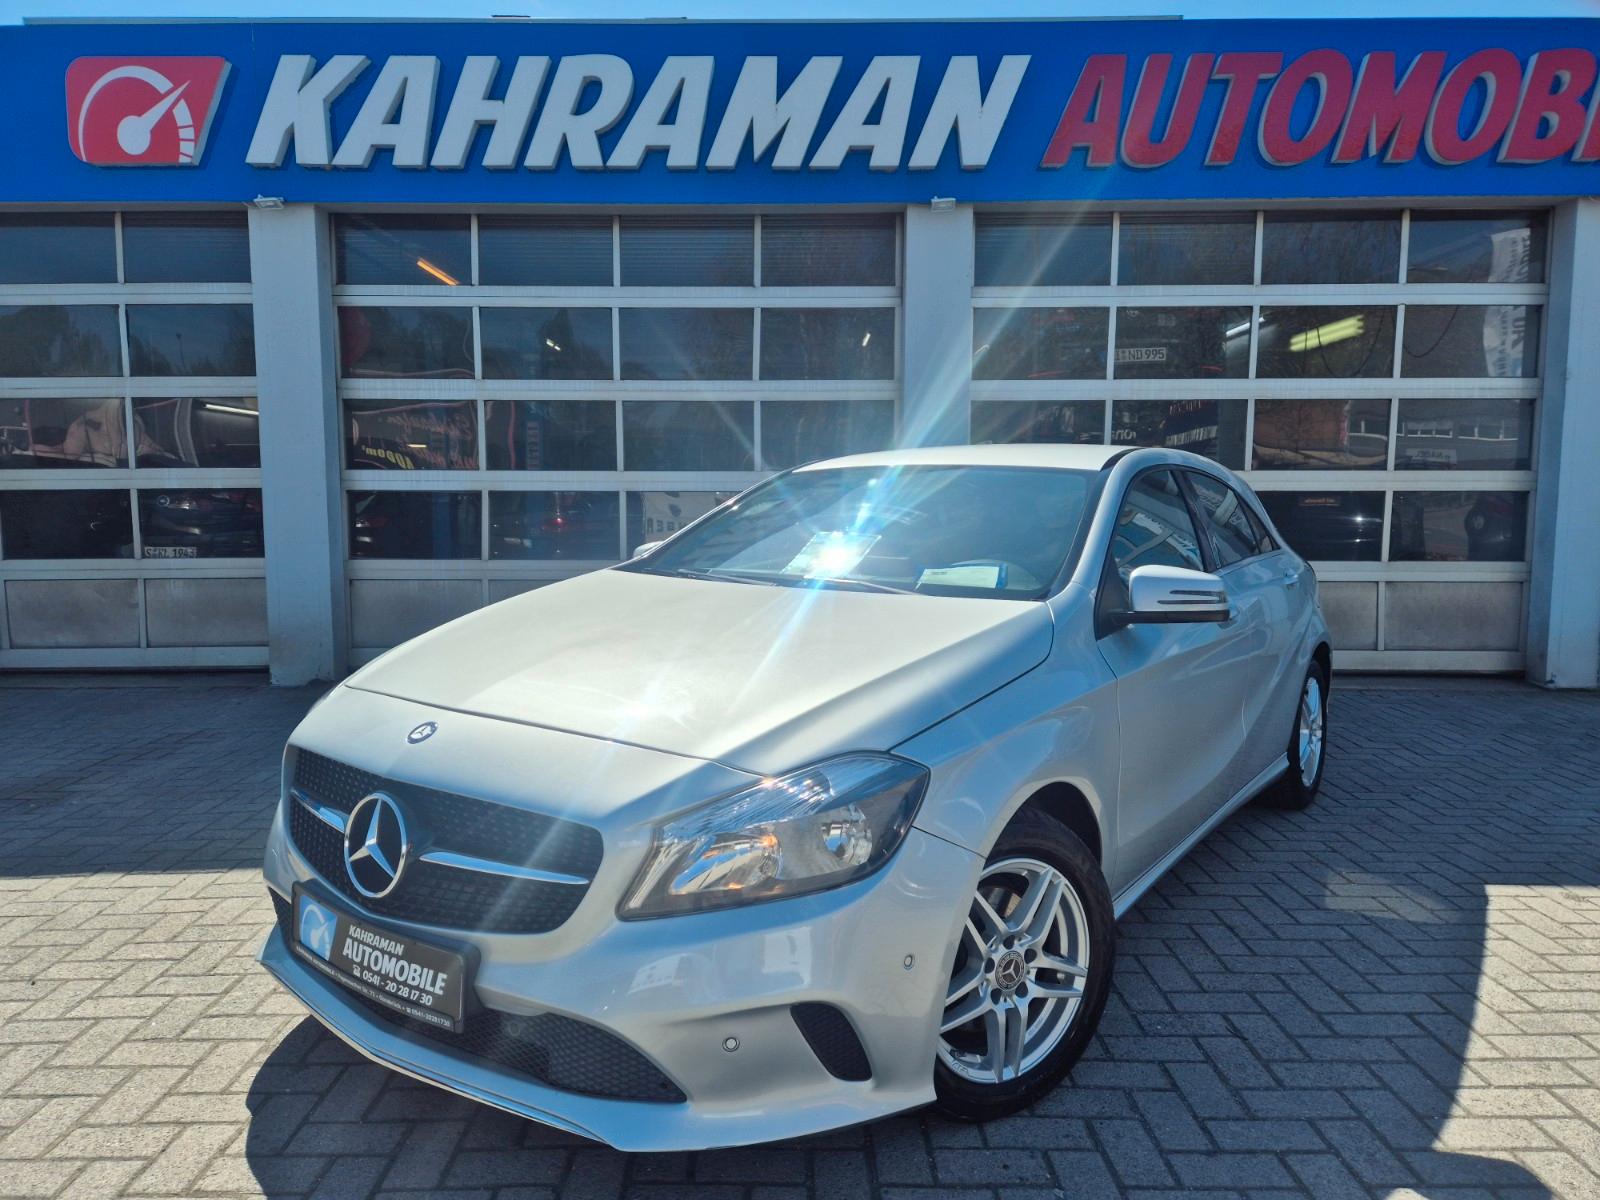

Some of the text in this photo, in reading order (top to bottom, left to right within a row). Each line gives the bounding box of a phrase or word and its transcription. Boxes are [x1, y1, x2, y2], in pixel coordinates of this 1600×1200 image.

[245, 53, 1031, 171] KAHRAMAN
[348, 924, 405, 956] KAHRAMAN
[342, 937, 448, 996] AUTOMOBILE
[362, 970, 380, 987] 0541
[385, 980, 397, 993] 20
[397, 985, 409, 998] 28
[410, 989, 420, 1001] 17
[419, 993, 433, 1006] 30
